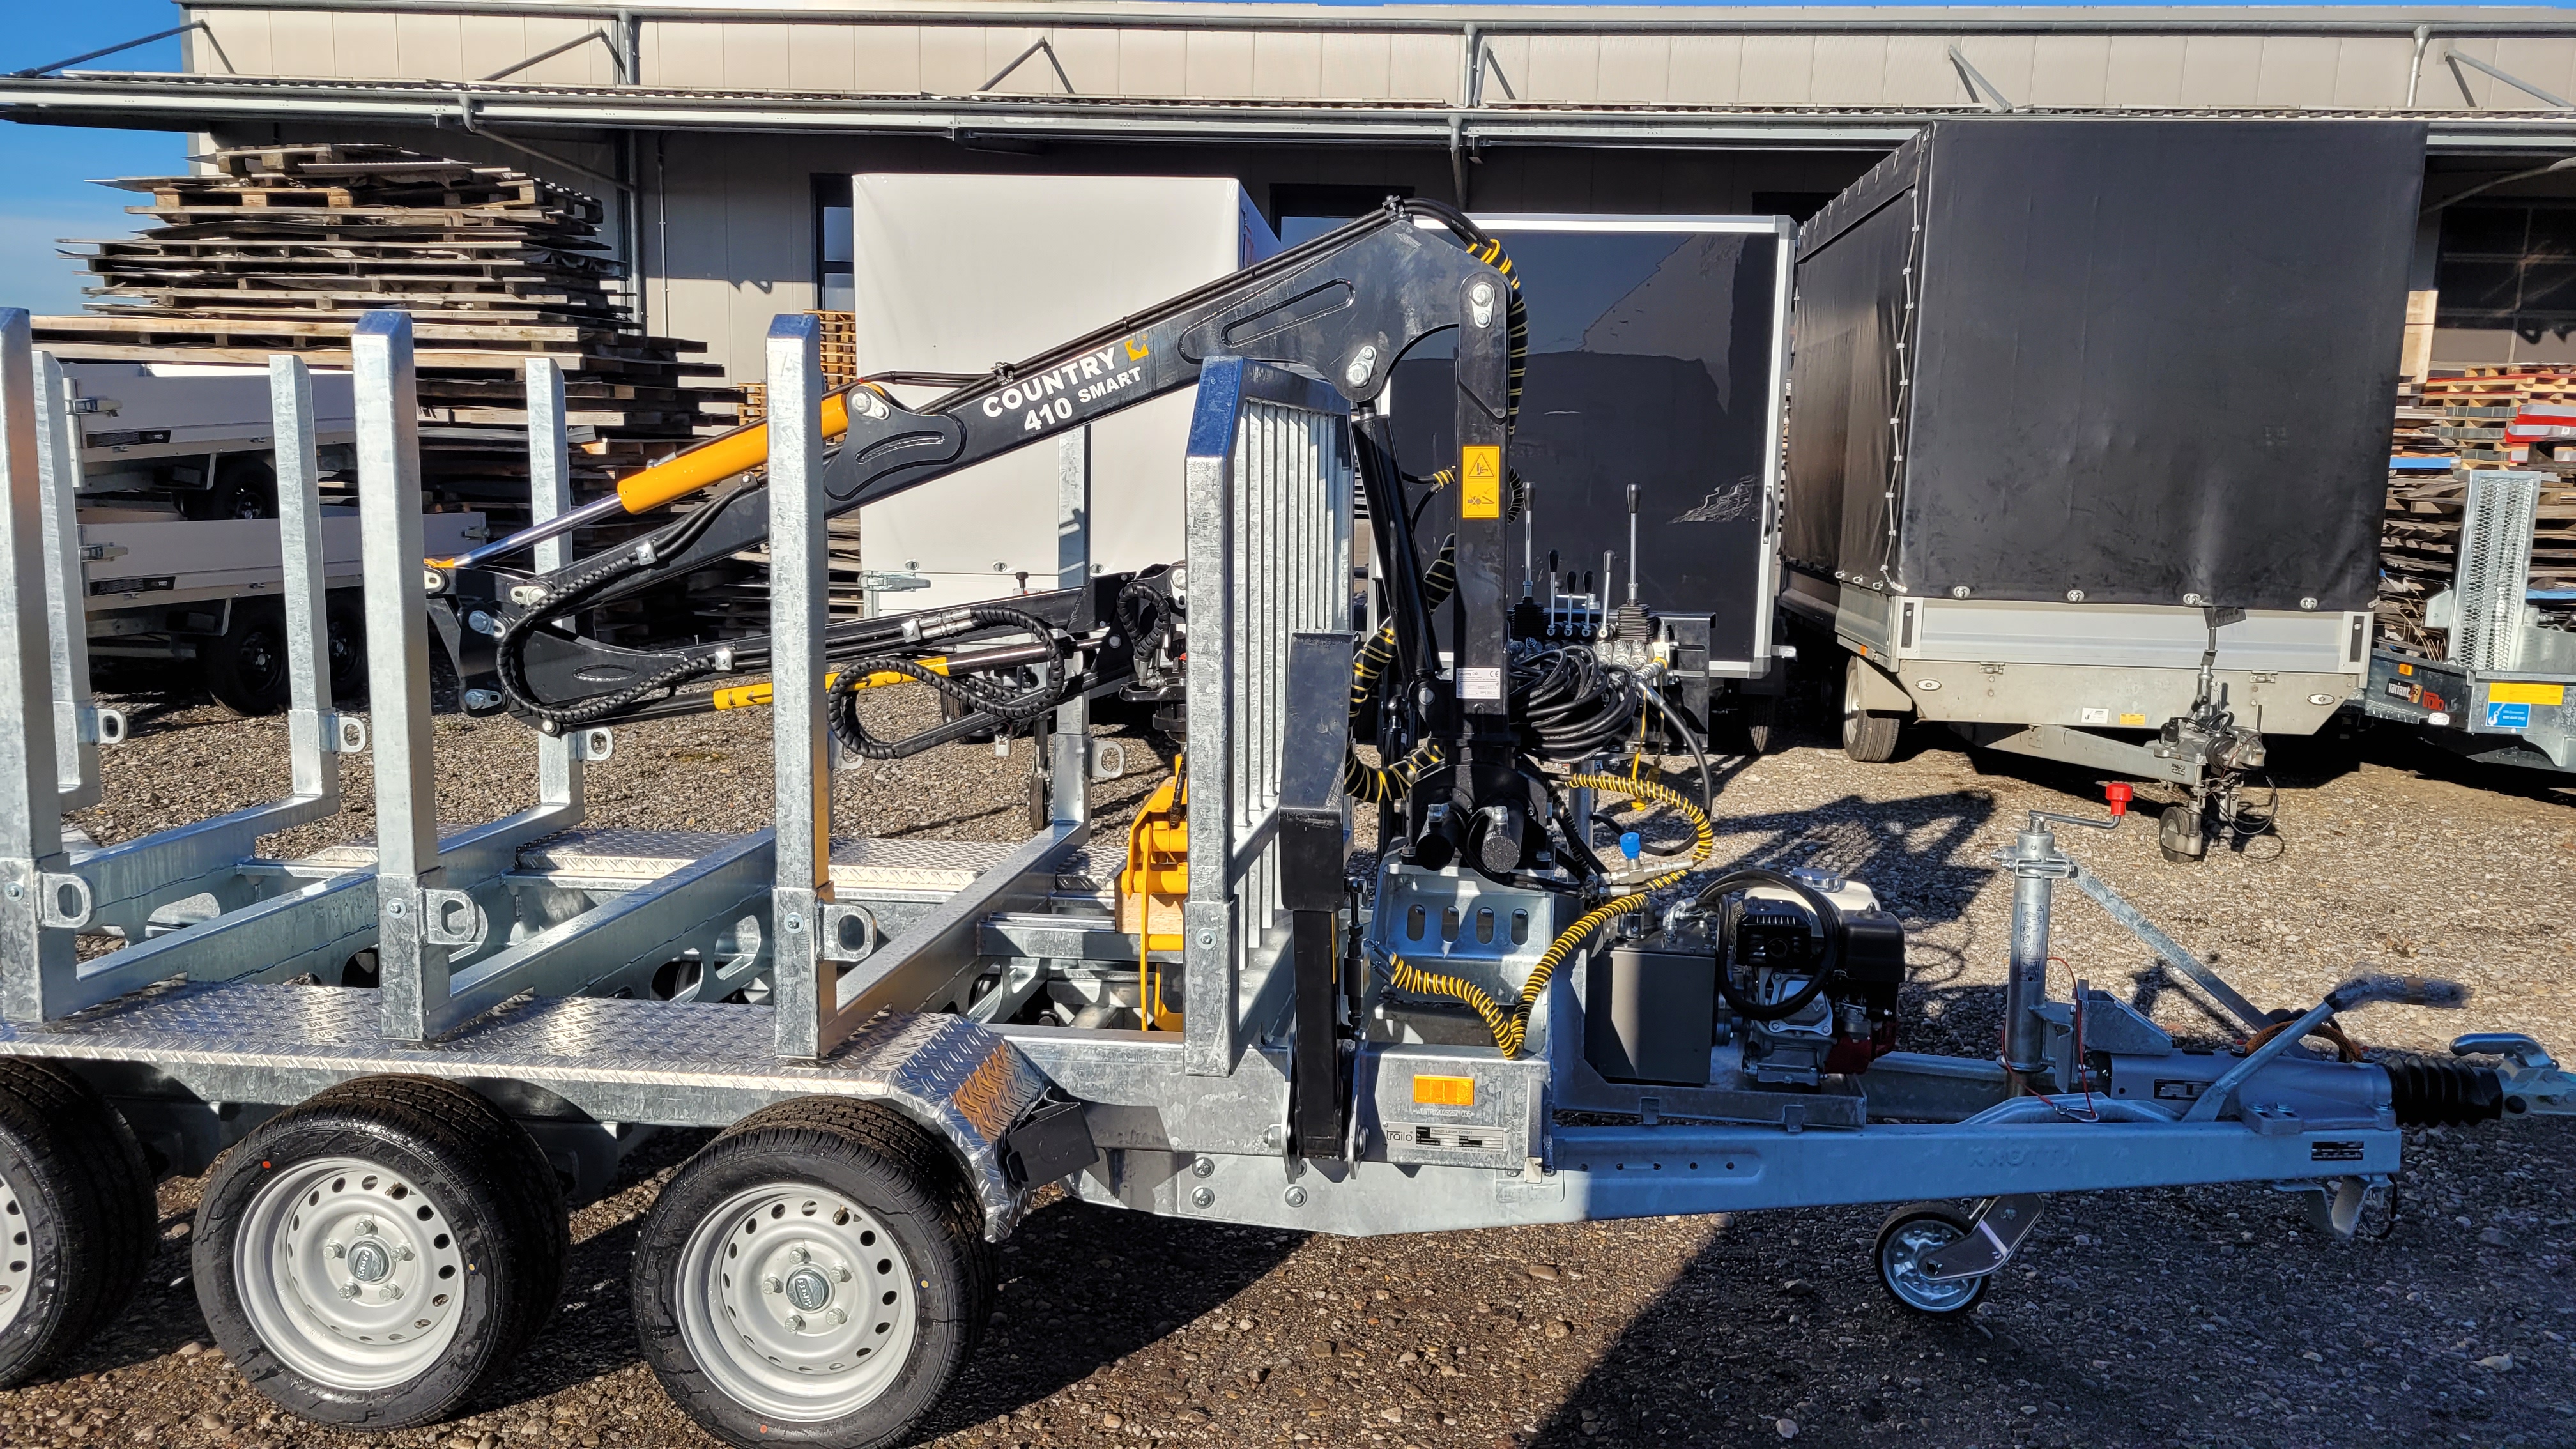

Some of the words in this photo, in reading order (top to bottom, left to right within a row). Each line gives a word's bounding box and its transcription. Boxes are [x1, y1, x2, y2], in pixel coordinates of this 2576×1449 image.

[983, 346, 1116, 417] COUNTRY
[1023, 397, 1073, 431] 410
[1077, 366, 1142, 403] SMART
[2388, 682, 2412, 698] variant
[1386, 1130, 1413, 1142] trailo
